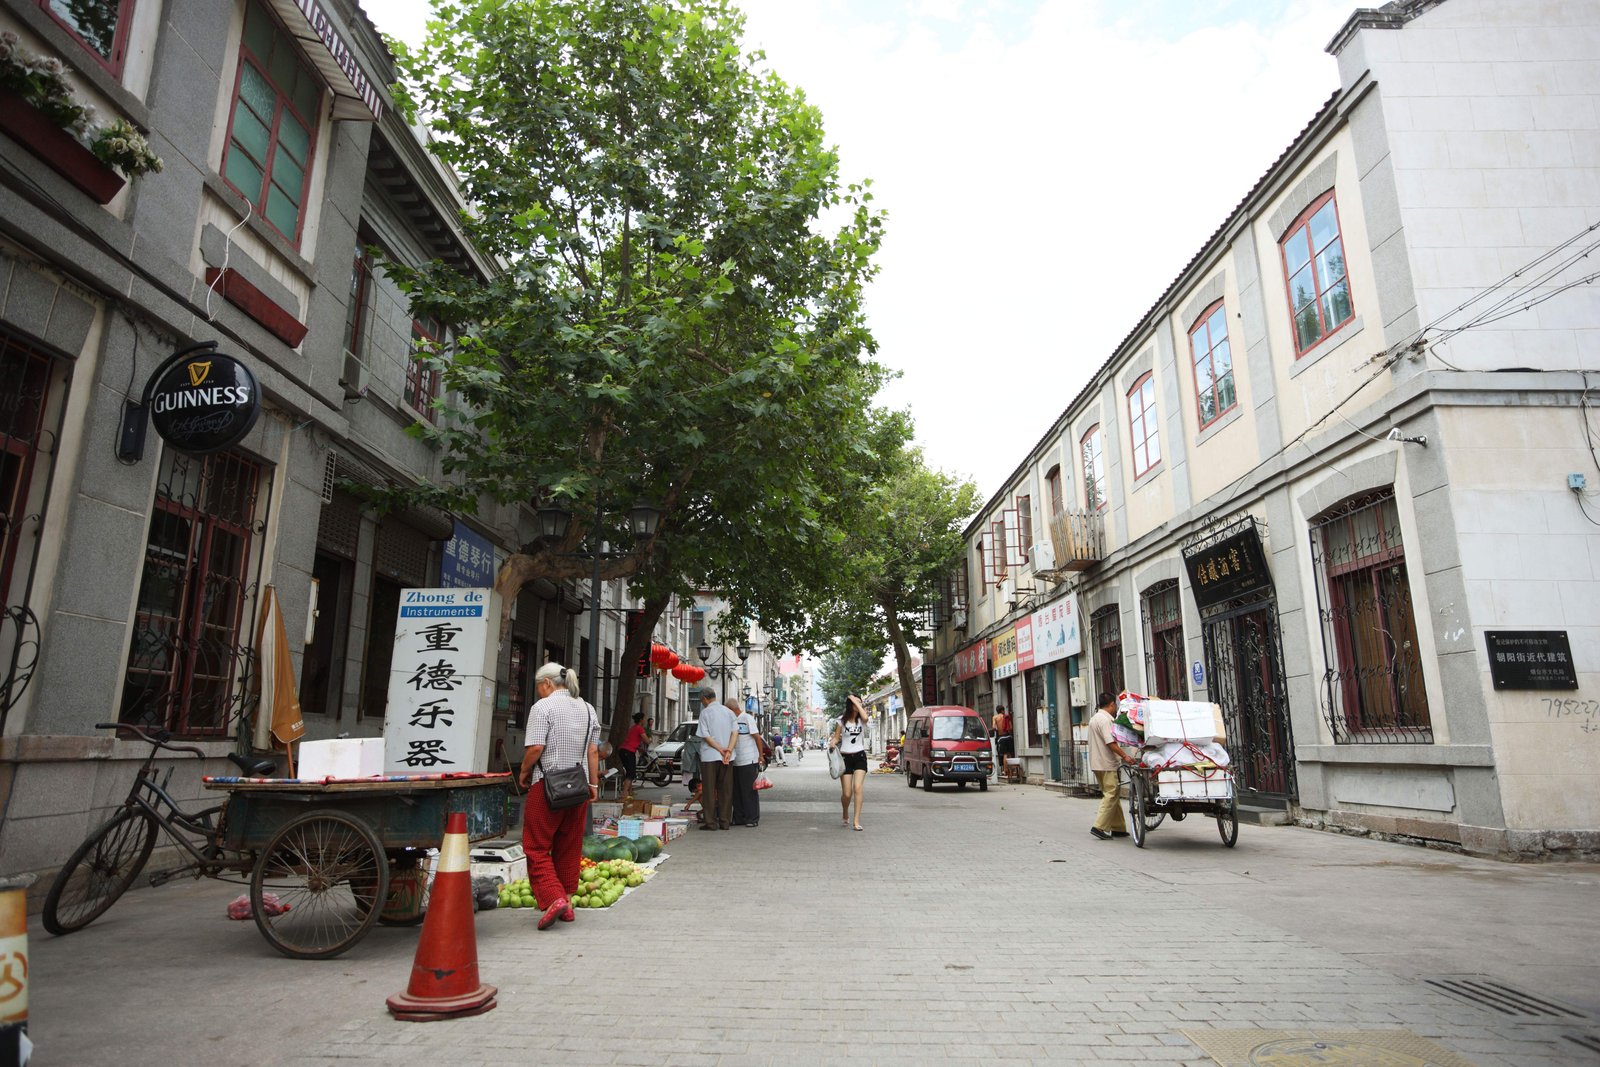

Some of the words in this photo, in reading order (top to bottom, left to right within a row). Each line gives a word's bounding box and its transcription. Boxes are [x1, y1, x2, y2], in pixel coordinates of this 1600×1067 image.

[154, 386, 250, 414] GUINNESS
[445, 534, 491, 575] 重德琴行
[406, 591, 456, 605] Zhong
[464, 591, 483, 602] de
[406, 606, 476, 617] Instruments
[1496, 651, 1568, 663] 朝阳街近代建筑
[395, 622, 463, 767] 重德乐器
[1541, 698, 1600, 718] 795227
